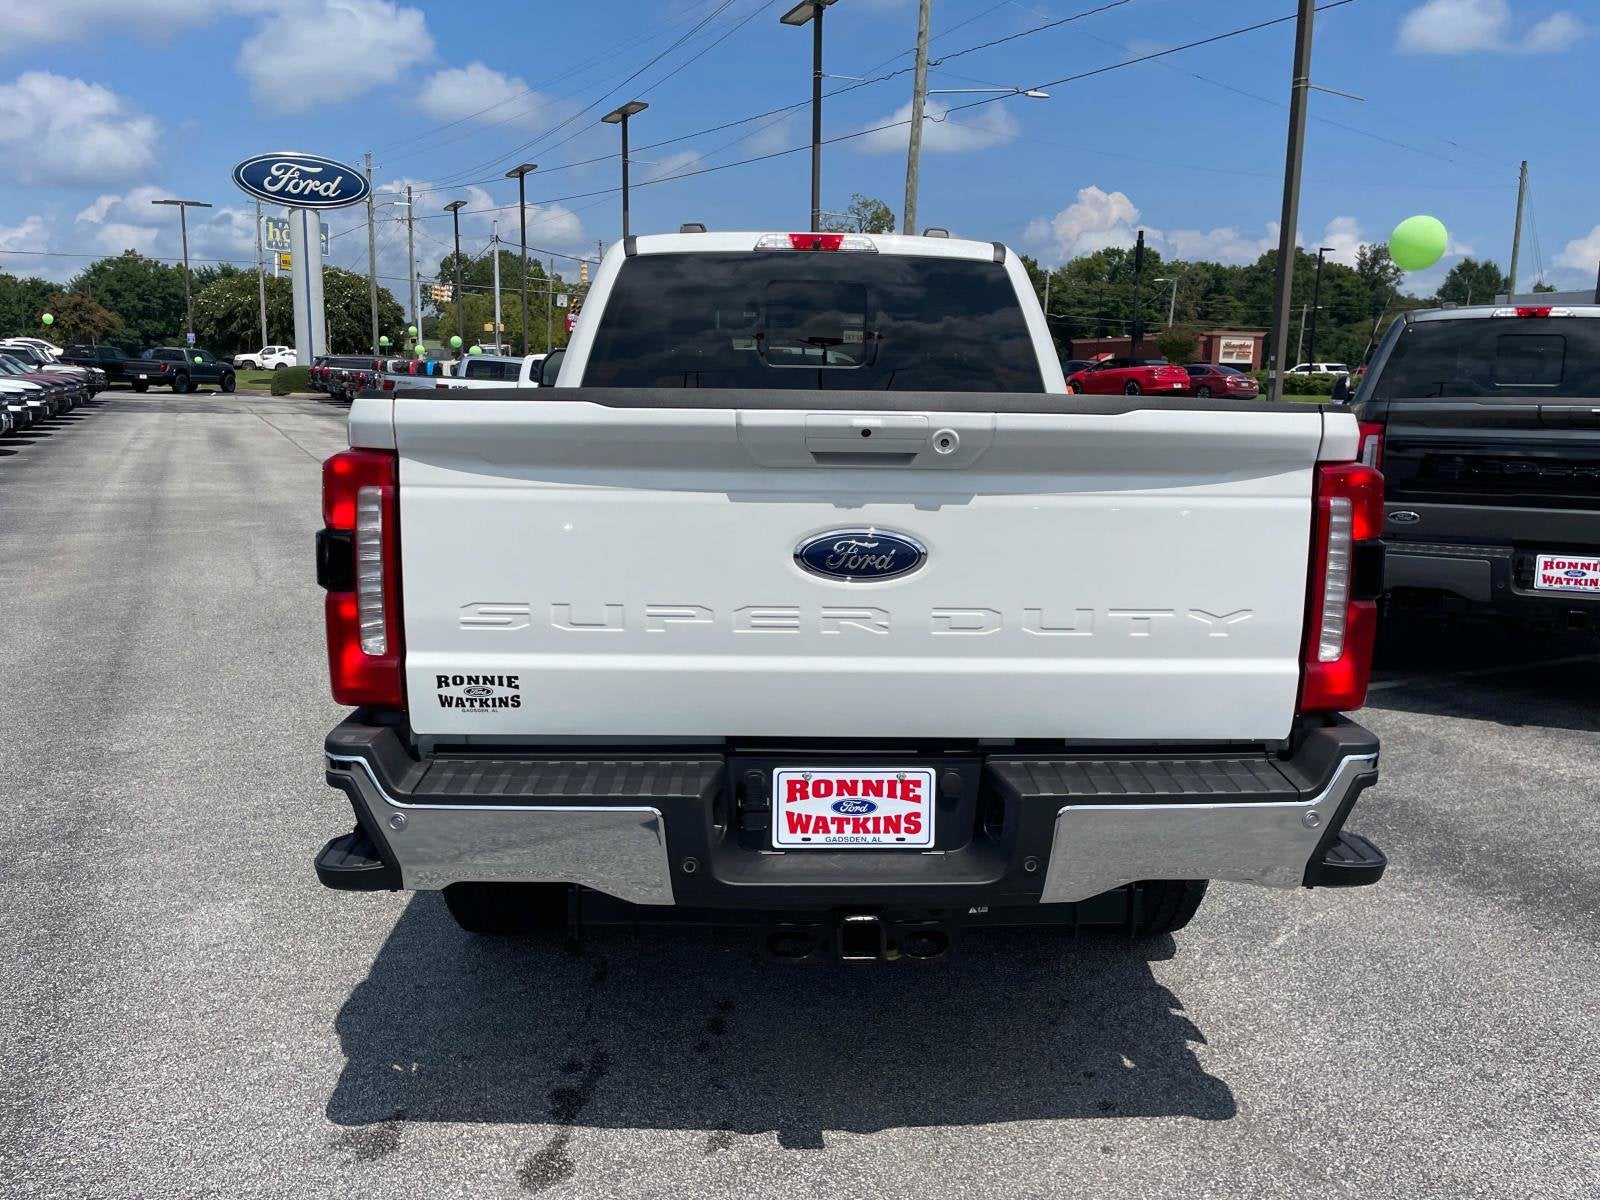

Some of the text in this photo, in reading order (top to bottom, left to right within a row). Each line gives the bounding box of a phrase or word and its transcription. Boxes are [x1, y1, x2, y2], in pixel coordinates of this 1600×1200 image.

[263, 162, 343, 197] Ford
[825, 540, 896, 570] Ford
[1543, 560, 1600, 572] RONNI
[1542, 574, 1600, 587] WATKIN
[460, 602, 1253, 637] SUPER DUTY
[436, 675, 519, 690] RONNIE
[437, 694, 521, 708] WATKINS
[786, 779, 922, 804] RONNIE
[839, 801, 868, 813] Ford
[785, 811, 922, 835] WATKINS
[825, 836, 870, 844] GADSDEN,
